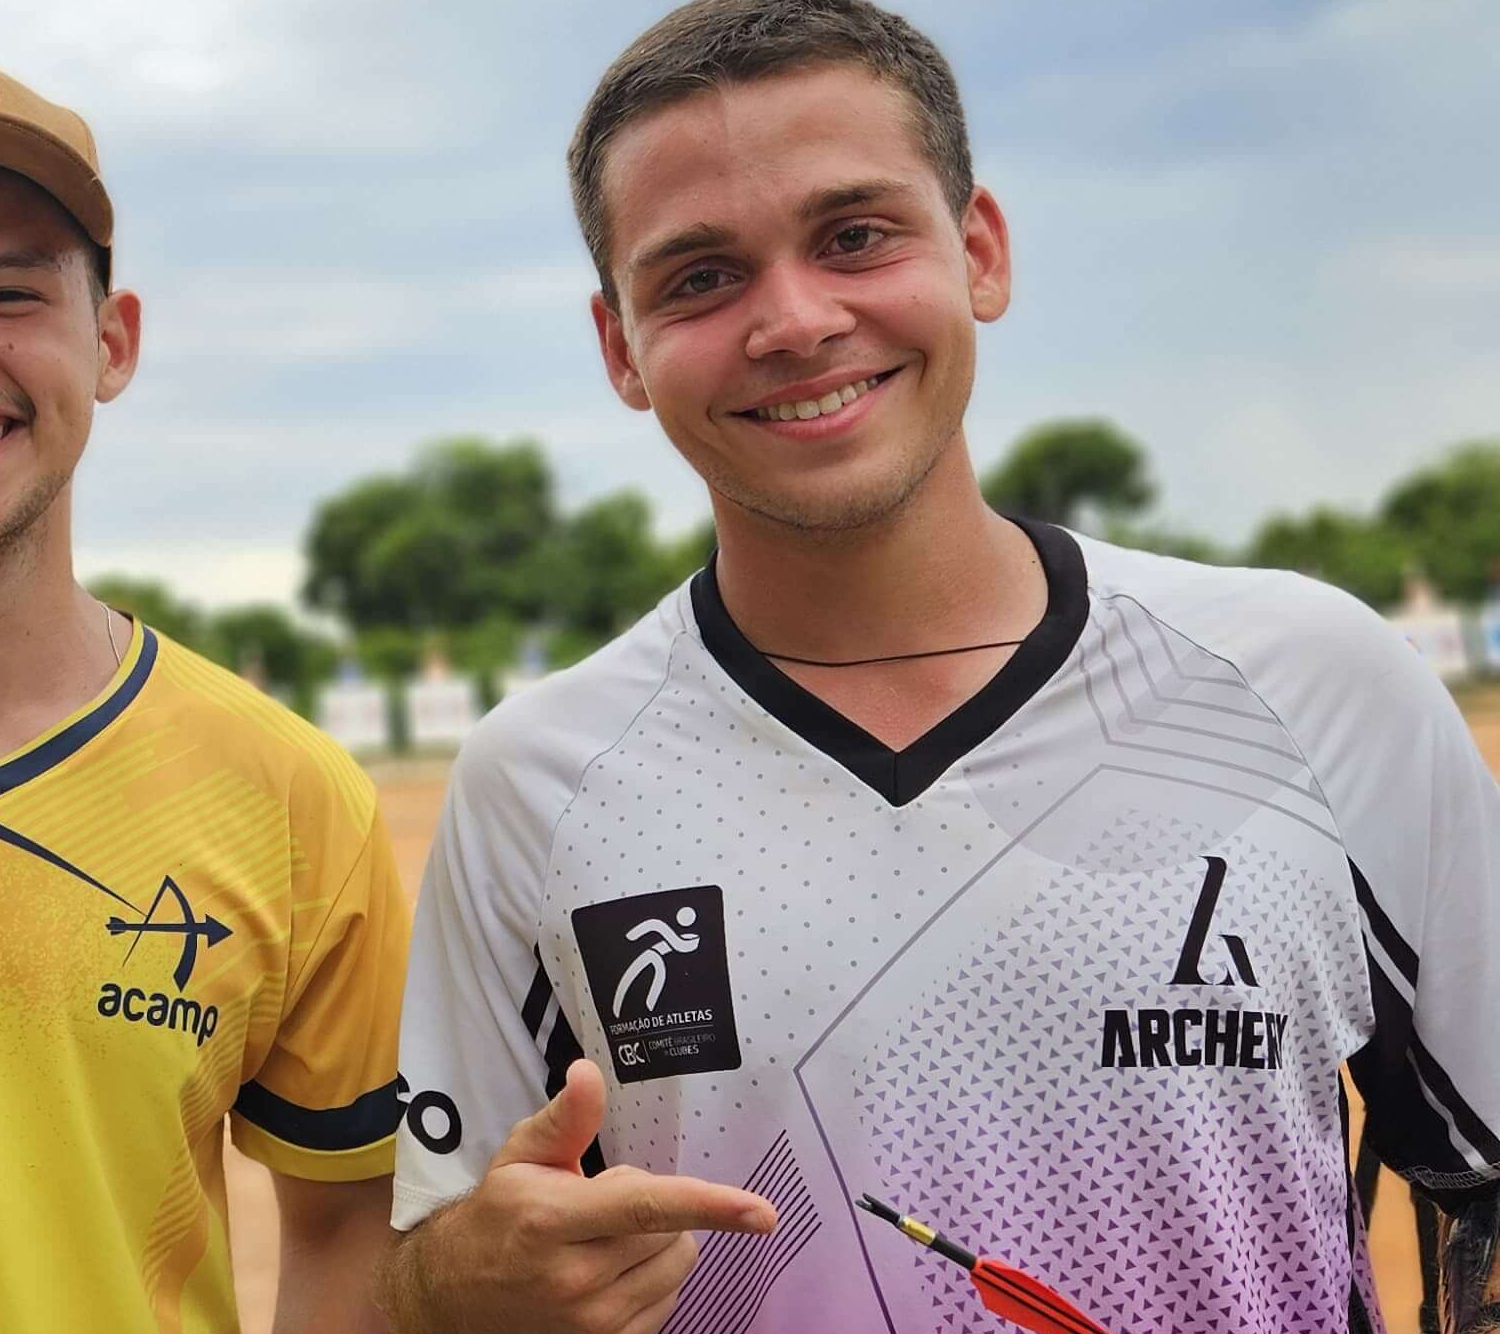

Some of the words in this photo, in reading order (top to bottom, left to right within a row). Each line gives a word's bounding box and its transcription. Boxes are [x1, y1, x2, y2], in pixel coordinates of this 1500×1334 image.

[97, 983, 218, 1047] acamp
[652, 1014, 665, 1028] DE
[666, 1009, 713, 1025] ATLETAS
[618, 1042, 646, 1066] CBC
